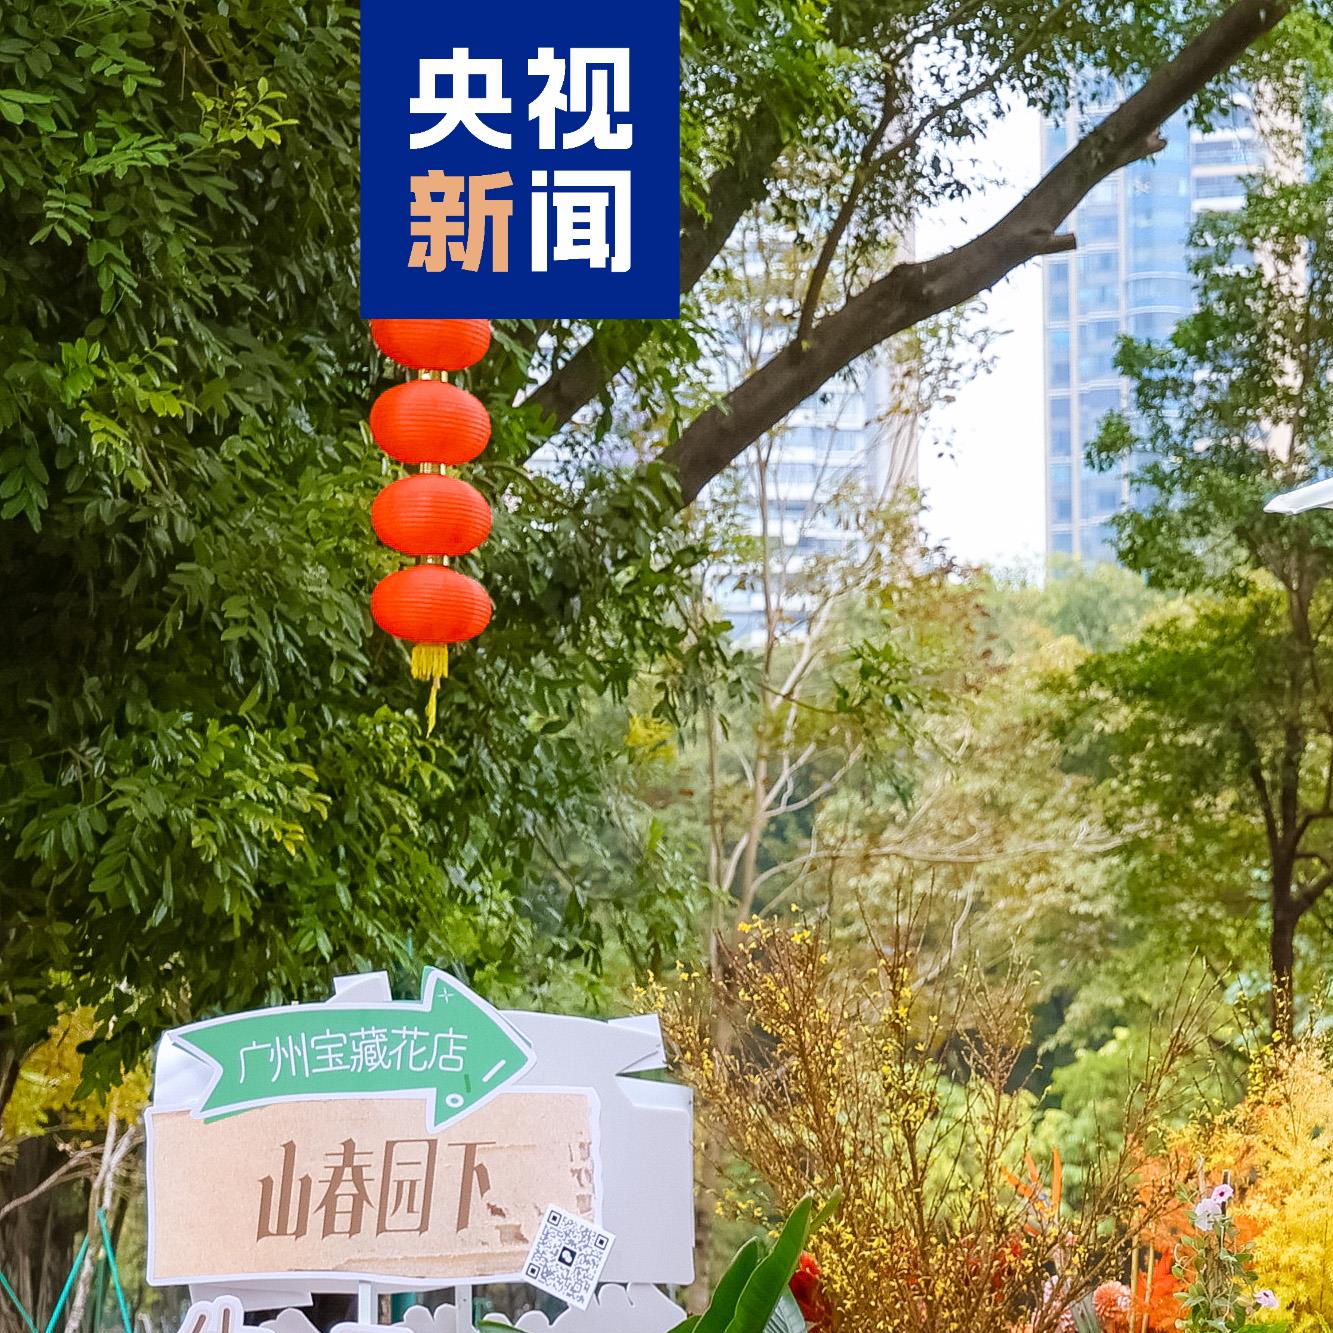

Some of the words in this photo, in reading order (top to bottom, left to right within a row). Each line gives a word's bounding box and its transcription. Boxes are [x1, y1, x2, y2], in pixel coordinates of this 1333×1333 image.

[238, 1027, 469, 1084] 广州宝藏花店
[256, 1136, 497, 1242] 山春园下
